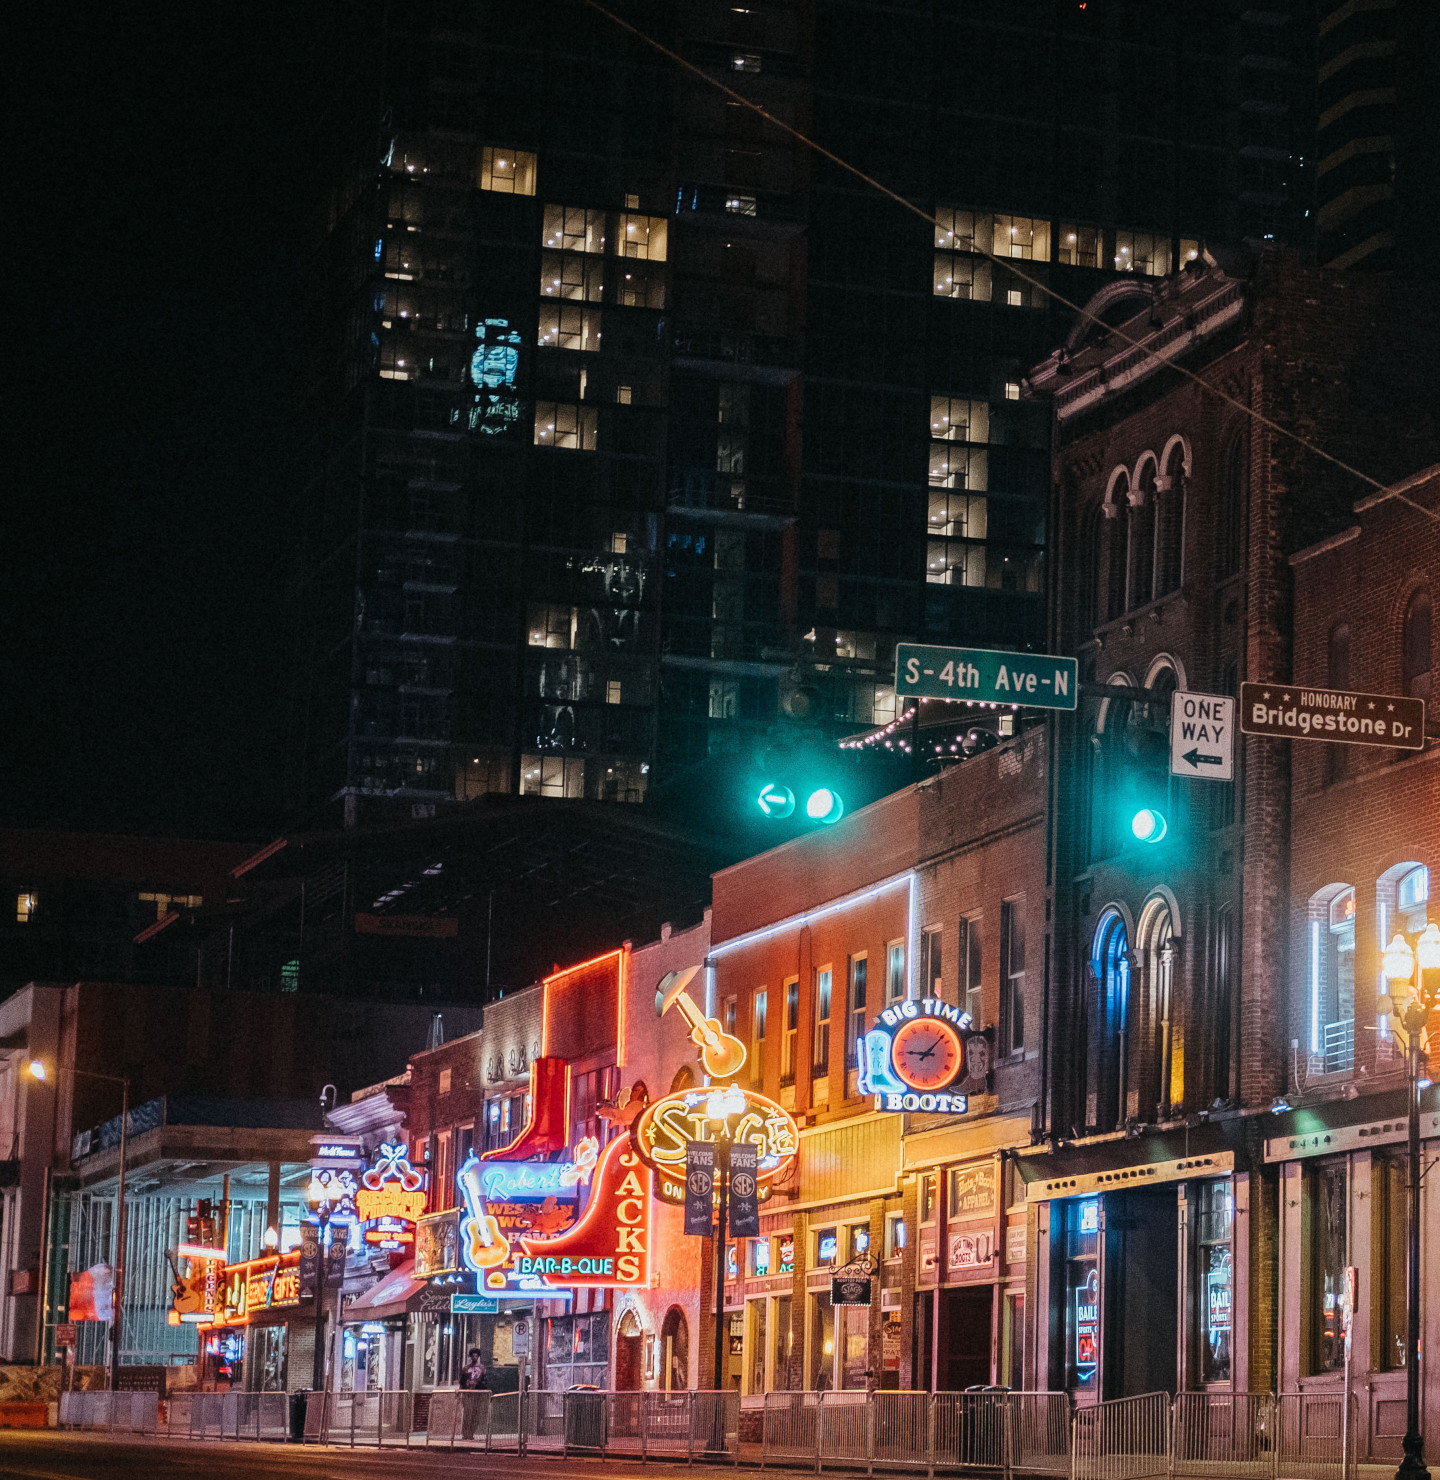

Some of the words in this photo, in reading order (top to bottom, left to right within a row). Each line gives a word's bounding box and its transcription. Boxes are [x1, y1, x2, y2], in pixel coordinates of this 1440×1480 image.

[1183, 700, 1225, 722] ONE
[1300, 691, 1358, 711] HONORARY
[1252, 703, 1387, 736] Bridgestone
[1391, 721, 1412, 738] Dr
[1182, 722, 1224, 744] WAY
[881, 999, 918, 1027] BIG
[922, 998, 973, 1030] TIME
[886, 1093, 967, 1113] BOOTS
[652, 1100, 797, 1164] STGE
[687, 1155, 714, 1166] FANS
[730, 1157, 757, 1168] FANS
[485, 1167, 561, 1201] Robert
[664, 1181, 682, 1199] ON
[691, 1173, 708, 1193] SEC
[735, 1175, 752, 1195] SEC
[521, 1256, 614, 1275] BAR-B-QUE
[955, 1252, 972, 1264] BOOTS
[420, 1290, 450, 1301] Secon
